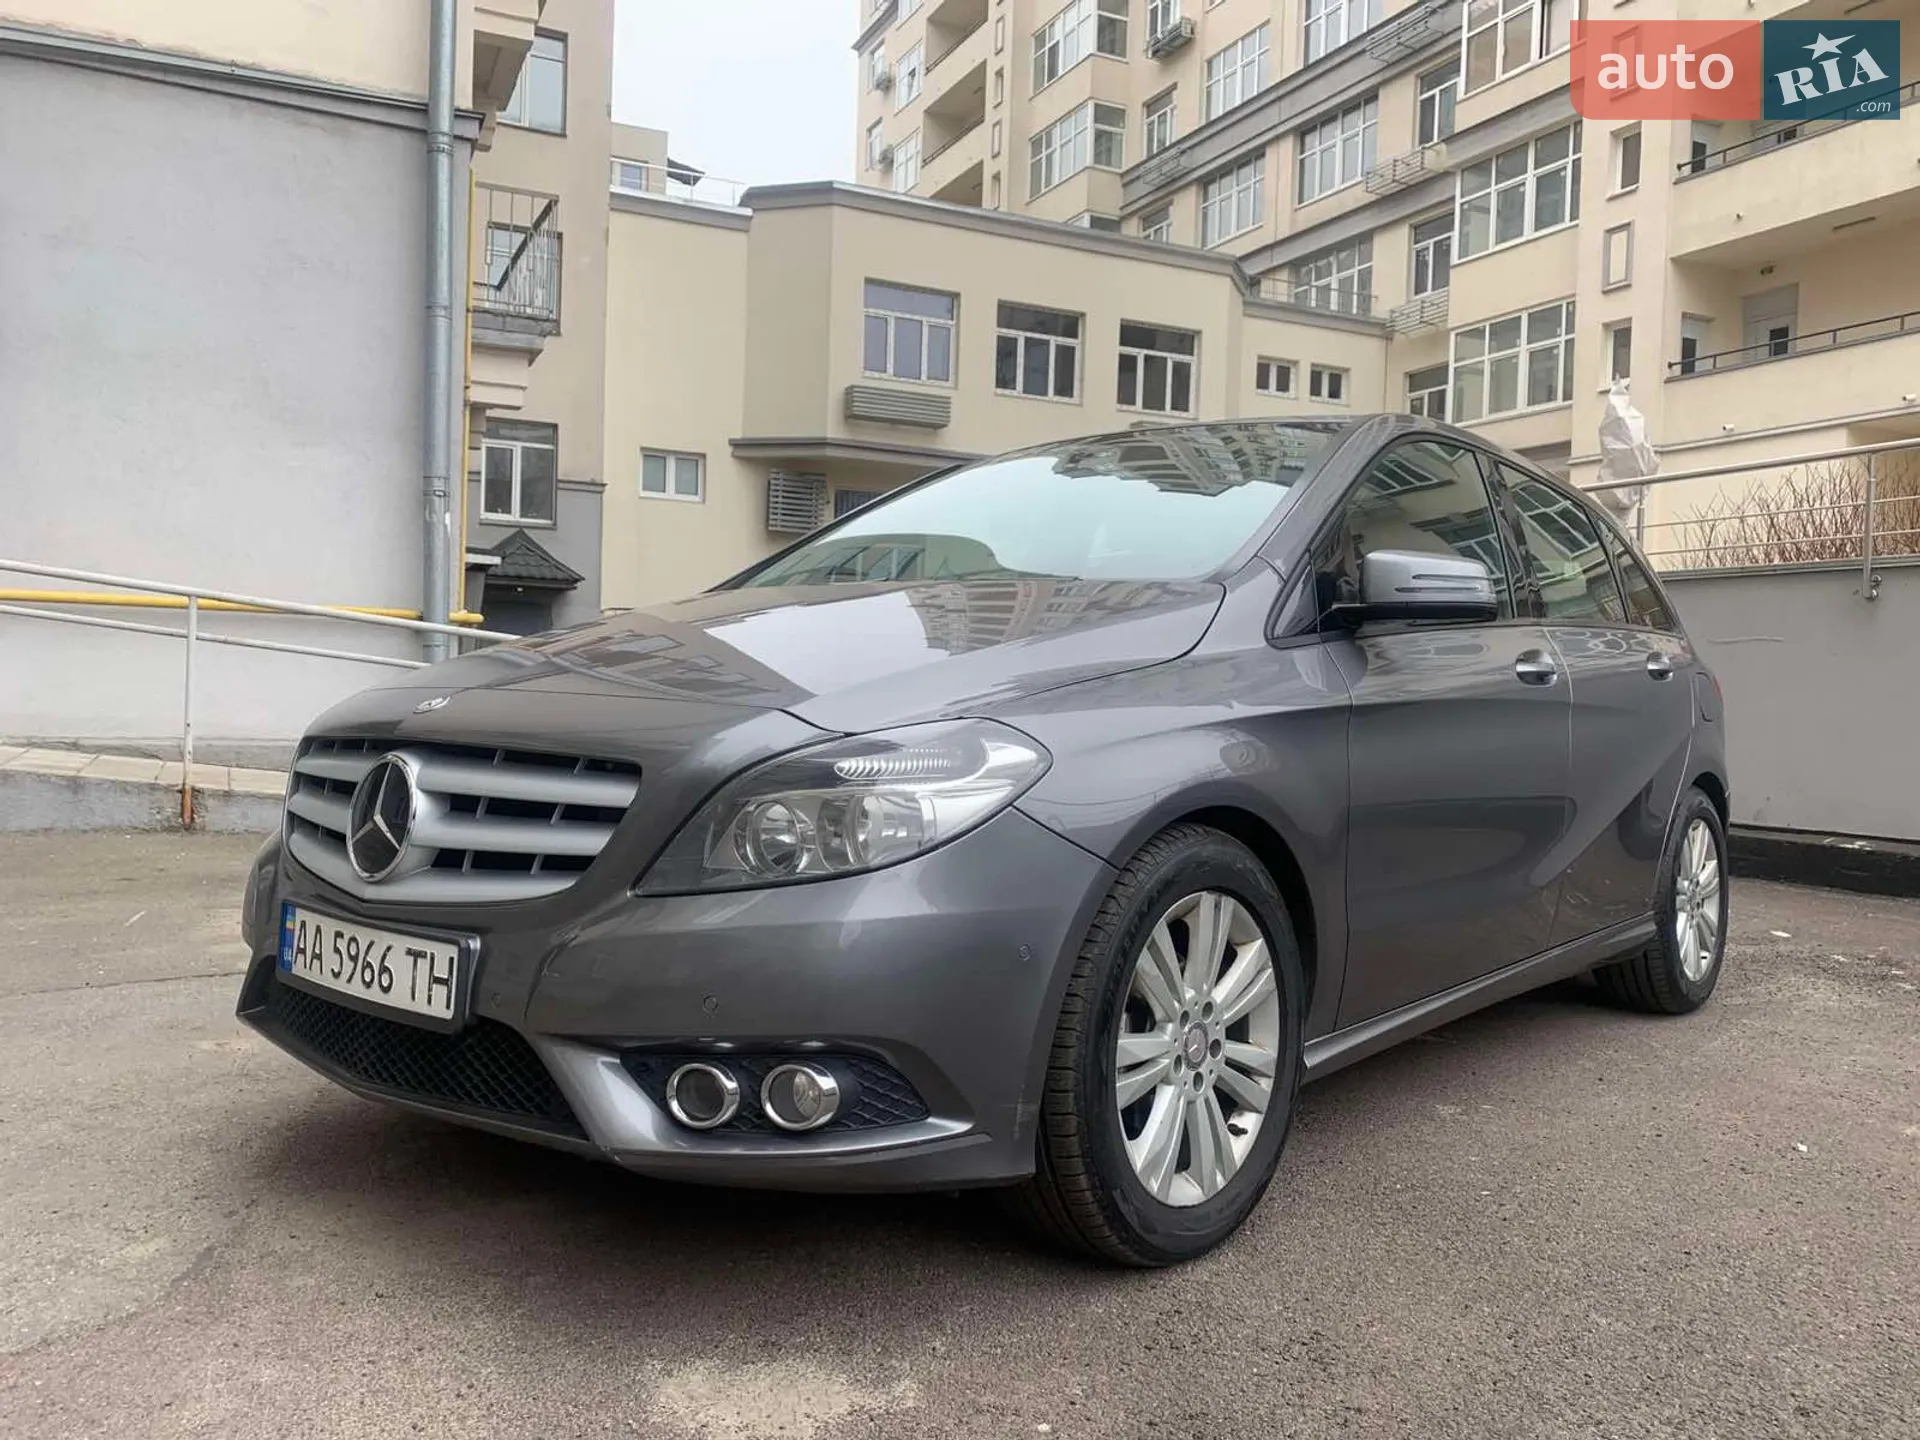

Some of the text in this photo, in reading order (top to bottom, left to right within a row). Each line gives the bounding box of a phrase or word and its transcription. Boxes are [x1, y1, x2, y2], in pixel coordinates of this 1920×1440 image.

[294, 920, 455, 1010] AA 5966 TH
